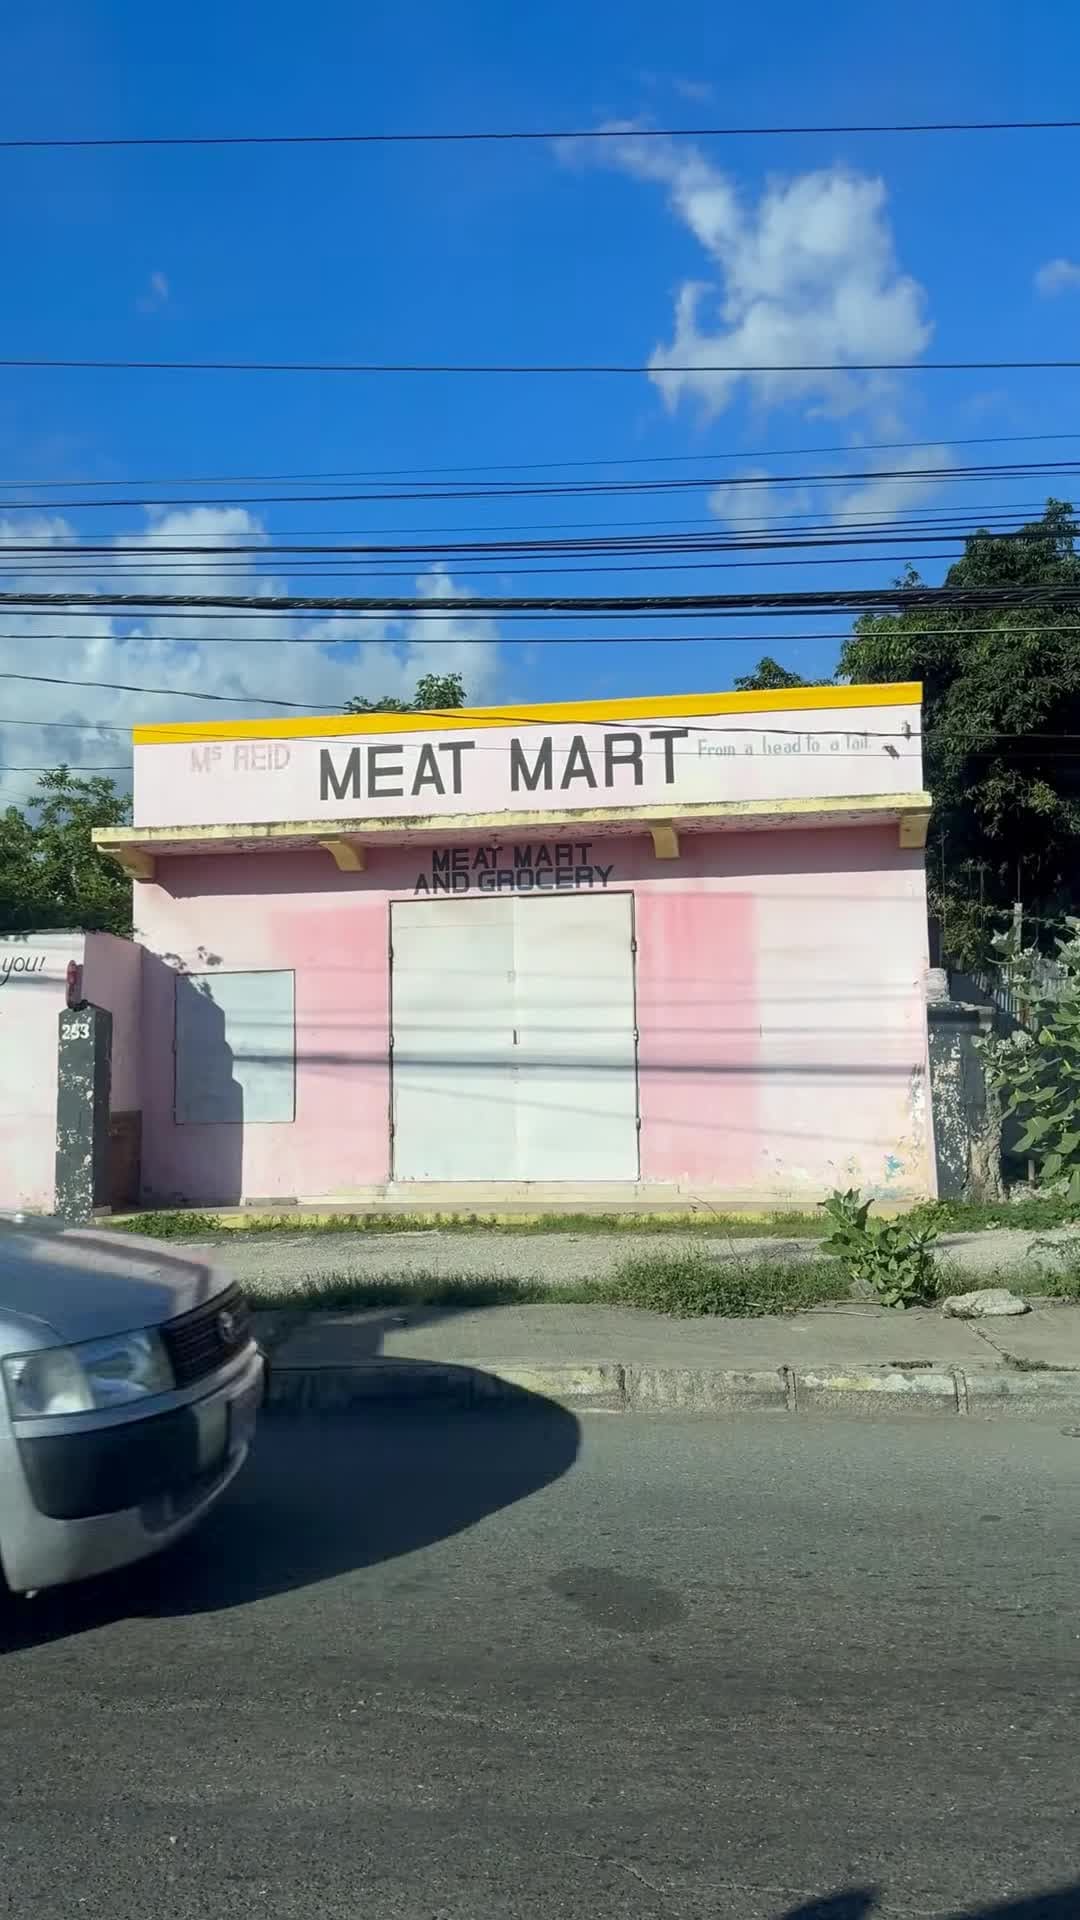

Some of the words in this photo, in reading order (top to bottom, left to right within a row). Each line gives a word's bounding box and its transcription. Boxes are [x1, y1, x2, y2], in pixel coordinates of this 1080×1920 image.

[697, 738, 736, 756] From
[744, 743, 753, 755] a
[762, 735, 801, 754] head
[829, 739, 840, 751] a
[233, 743, 290, 770] REID
[319, 741, 475, 800] MEAT
[510, 730, 689, 791] MART
[432, 847, 503, 872] MEAT
[513, 843, 593, 868] MART
[414, 872, 470, 895] AND
[478, 865, 614, 892] GROCERY
[0, 957, 46, 986] you!
[61, 1023, 90, 1040] 253
